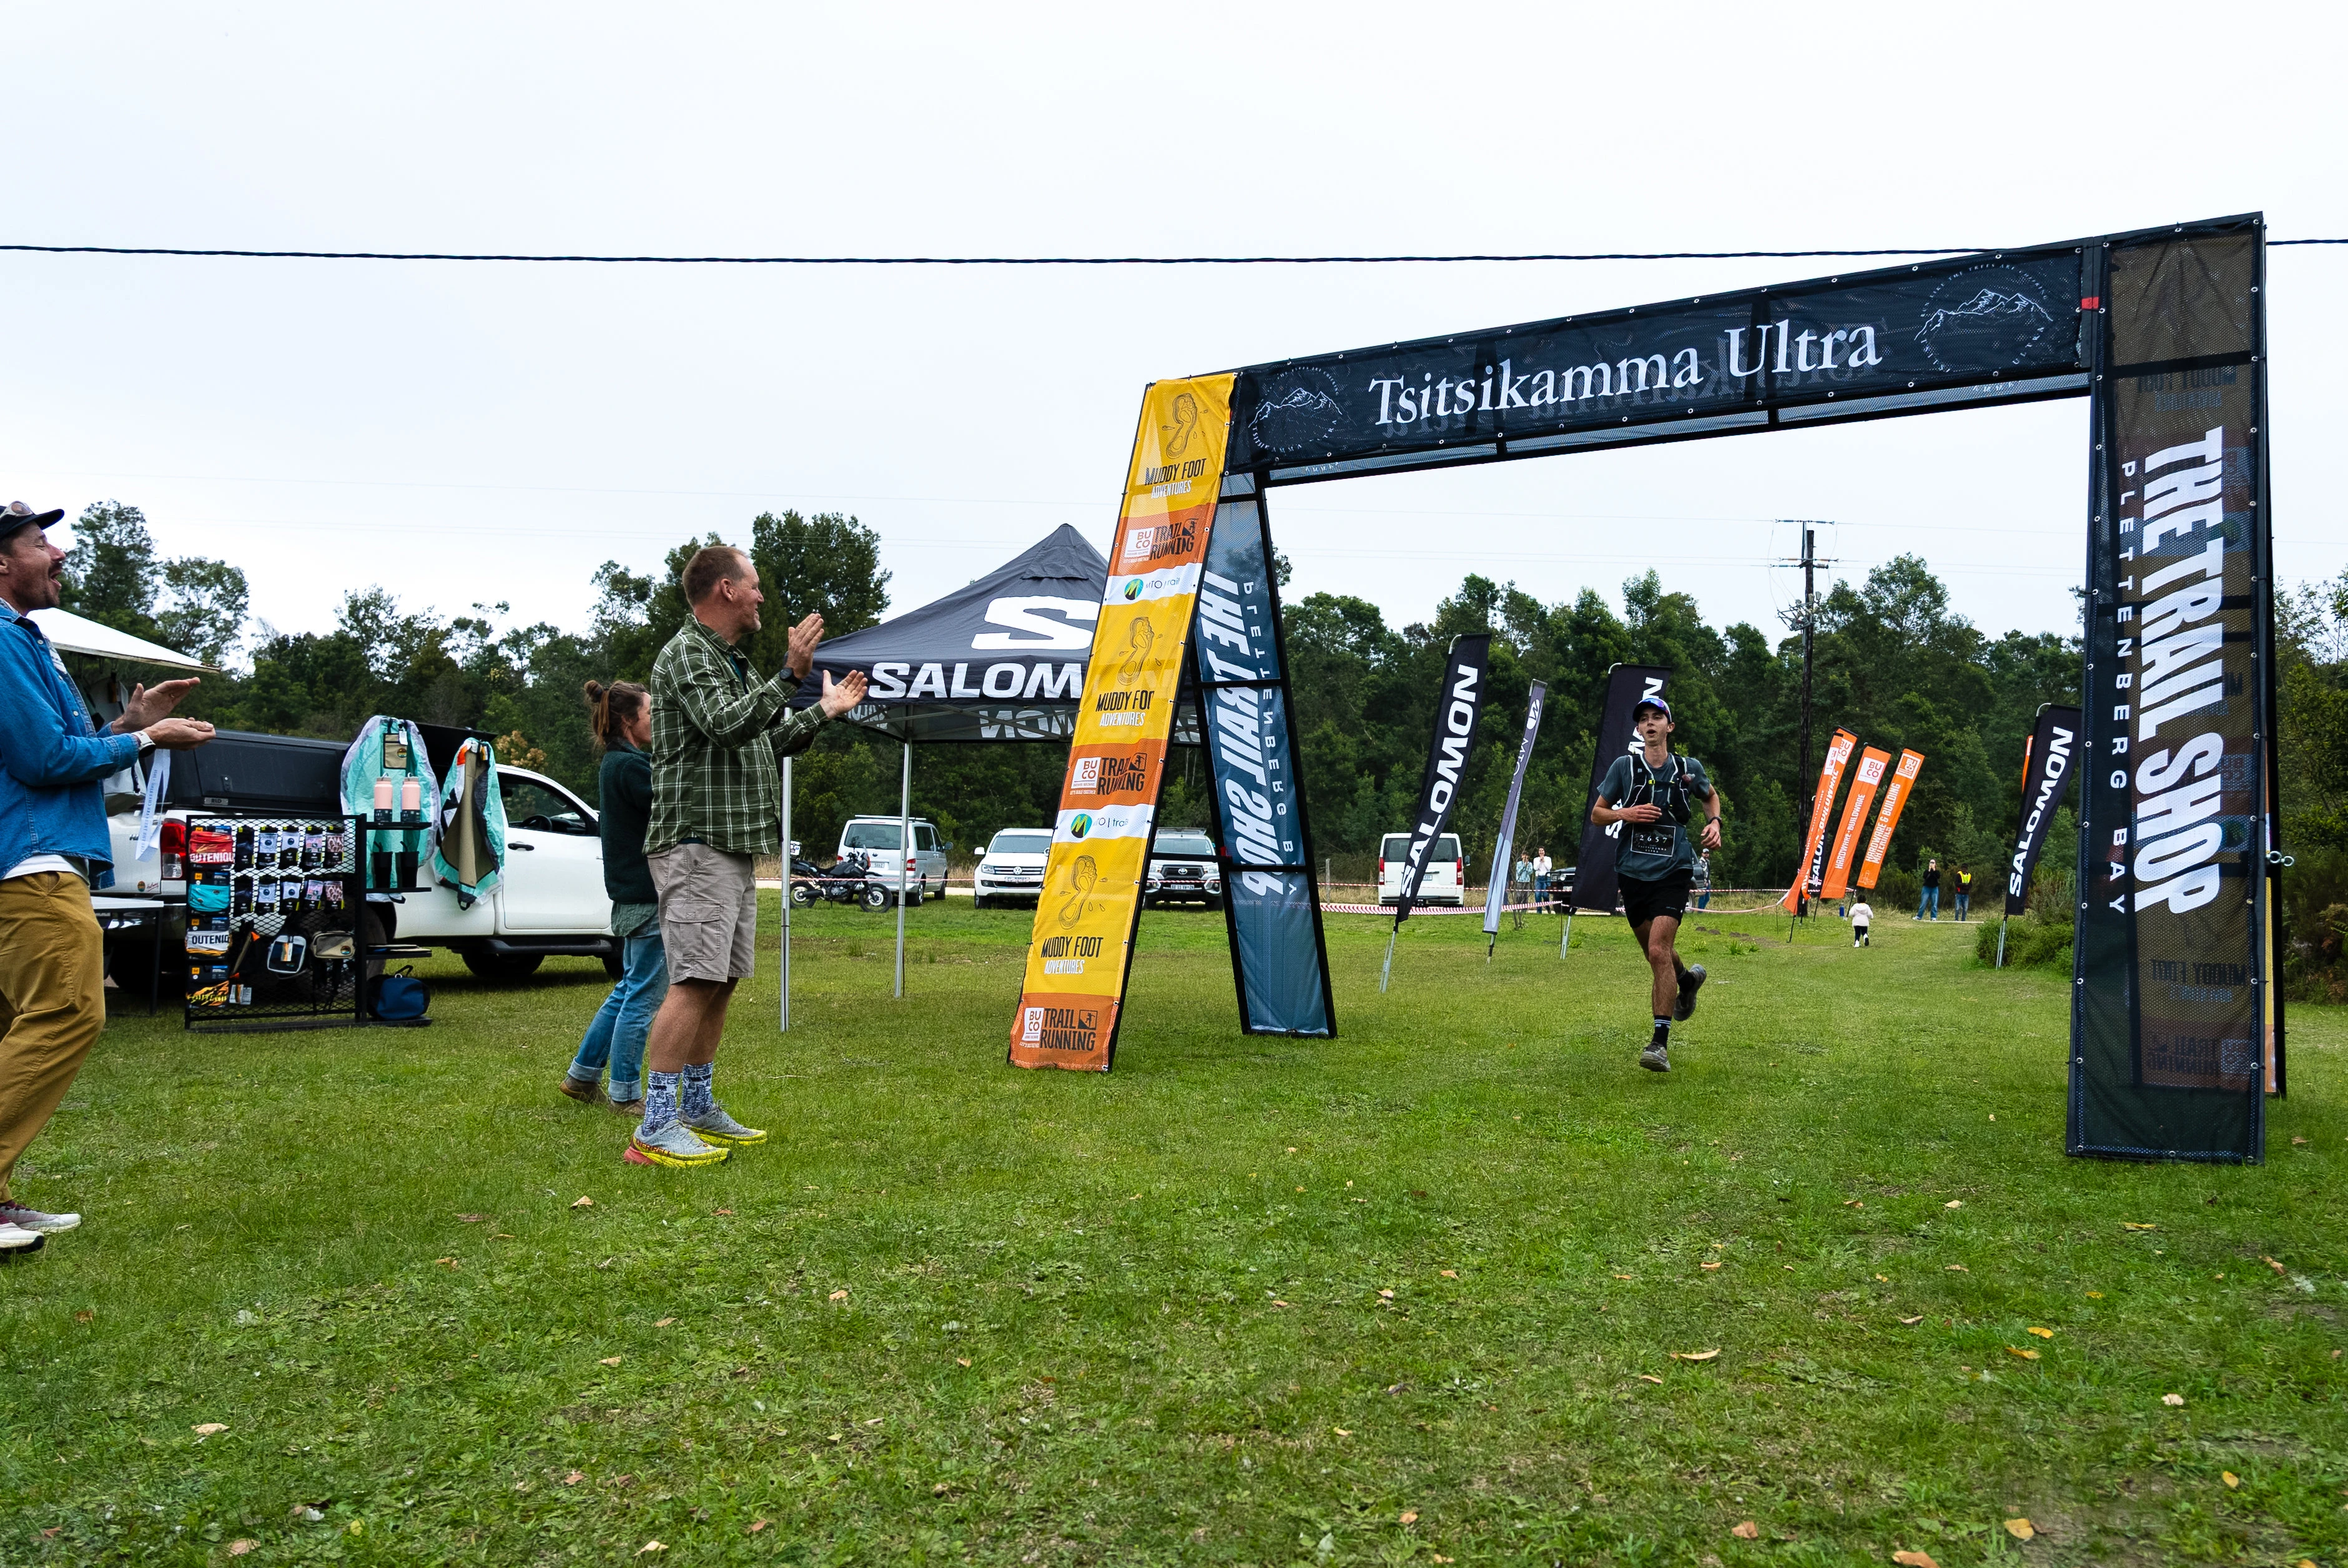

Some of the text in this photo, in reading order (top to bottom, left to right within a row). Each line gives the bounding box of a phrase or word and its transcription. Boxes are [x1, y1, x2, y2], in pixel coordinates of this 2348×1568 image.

[1368, 319, 1883, 425] Tsitsikamma Ultra
[1145, 458, 1207, 486] MUDDY FOOT
[1151, 480, 1192, 498] ADVENTURES
[2143, 425, 2223, 555] THE
[1137, 530, 1152, 540] BU
[1155, 522, 1182, 543] TRAIL
[1136, 540, 1150, 549] CO
[1149, 535, 1195, 560] RUNNING
[2139, 536, 2224, 742] TRAIL
[869, 662, 1082, 699] SALOM
[2109, 460, 2136, 914] PLETTENBERG BAY
[1095, 691, 1132, 712] MUDDY
[1100, 712, 1146, 727] ADVENTURES
[1082, 770, 1097, 779] CO
[1083, 760, 1098, 770] BU
[1867, 769, 1879, 779] CO
[1868, 761, 1882, 771] BU
[1401, 664, 1479, 898] SALOMON
[1865, 822, 1887, 862] HARDWARE
[1882, 782, 1902, 817] BUILDING
[2010, 726, 2074, 897] SALOMON
[2133, 732, 2224, 914] SHOP
[1639, 834, 1668, 843] 2657
[1041, 936, 1104, 958] MUDDY FOOT
[1044, 959, 1085, 974] ADVENTURES
[1029, 1010, 1042, 1021] BU
[1043, 1007, 1076, 1029] TRAIL
[1028, 1021, 1040, 1032] CO
[1040, 1028, 1097, 1052] RUNNING
